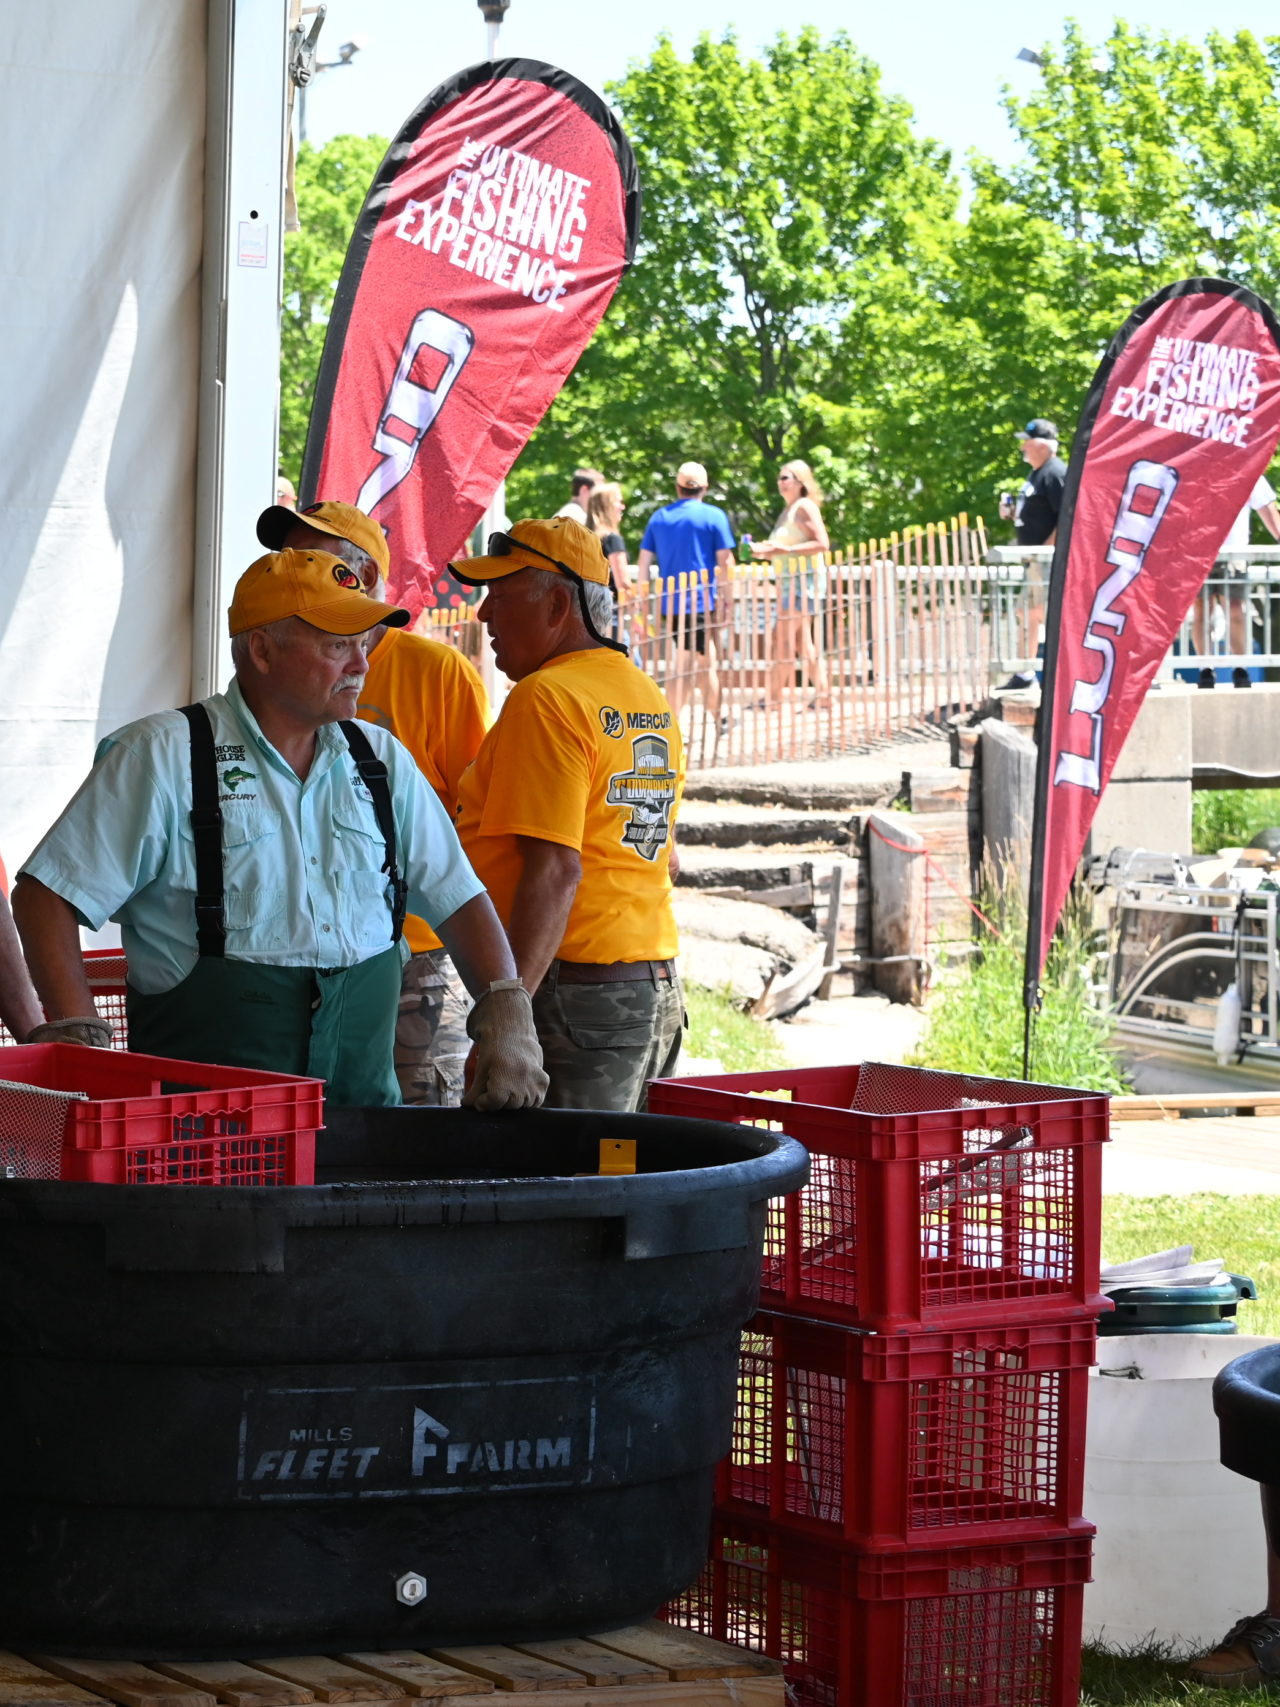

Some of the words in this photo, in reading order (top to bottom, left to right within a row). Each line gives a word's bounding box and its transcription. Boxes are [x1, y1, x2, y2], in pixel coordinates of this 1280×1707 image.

[455, 136, 487, 168] THE
[480, 144, 591, 218] ULTIMATE
[439, 168, 588, 264] FISHING
[395, 199, 577, 313] EXPERIENCE
[1150, 335, 1174, 359] THE
[1172, 337, 1261, 374] ULTIMATE
[1144, 359, 1260, 411] FISHING
[1110, 386, 1254, 448] EXPERIENCE
[627, 712, 673, 729] MERCUR
[219, 793, 257, 802] RCURY
[614, 778, 676, 800] TOURNAMEN
[289, 1426, 353, 1442] MILLS
[251, 1446, 381, 1481] FLEET
[446, 1436, 572, 1475] FARM
